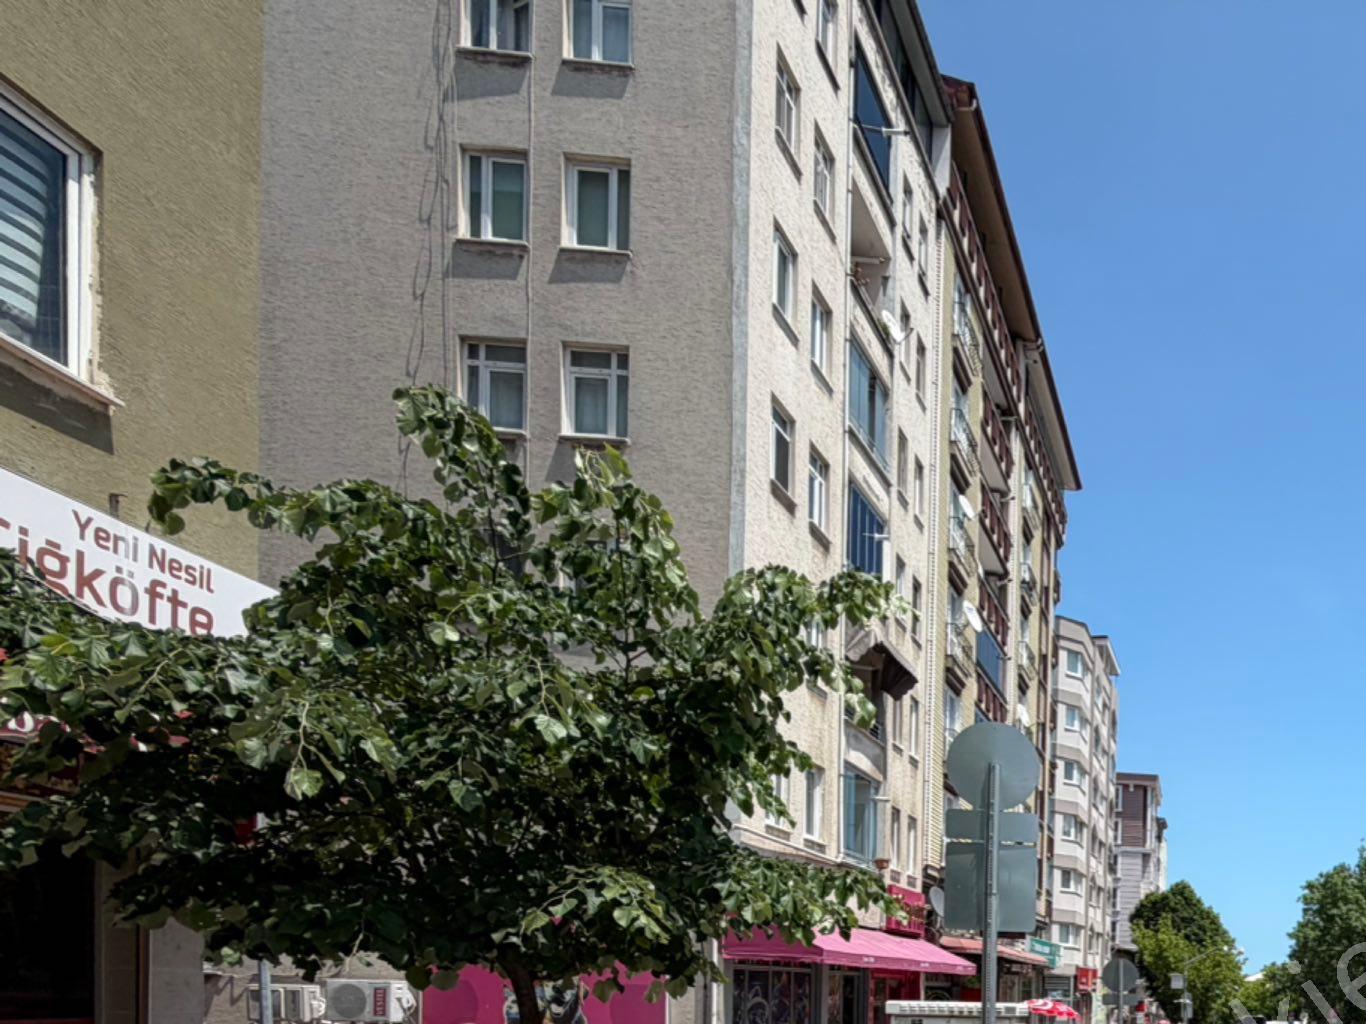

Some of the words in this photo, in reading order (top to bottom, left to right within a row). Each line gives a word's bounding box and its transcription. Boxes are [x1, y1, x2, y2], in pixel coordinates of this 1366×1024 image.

[0, 516, 214, 637] iğköfte
[72, 509, 139, 563] Yeni
[149, 543, 214, 594] Nesil
